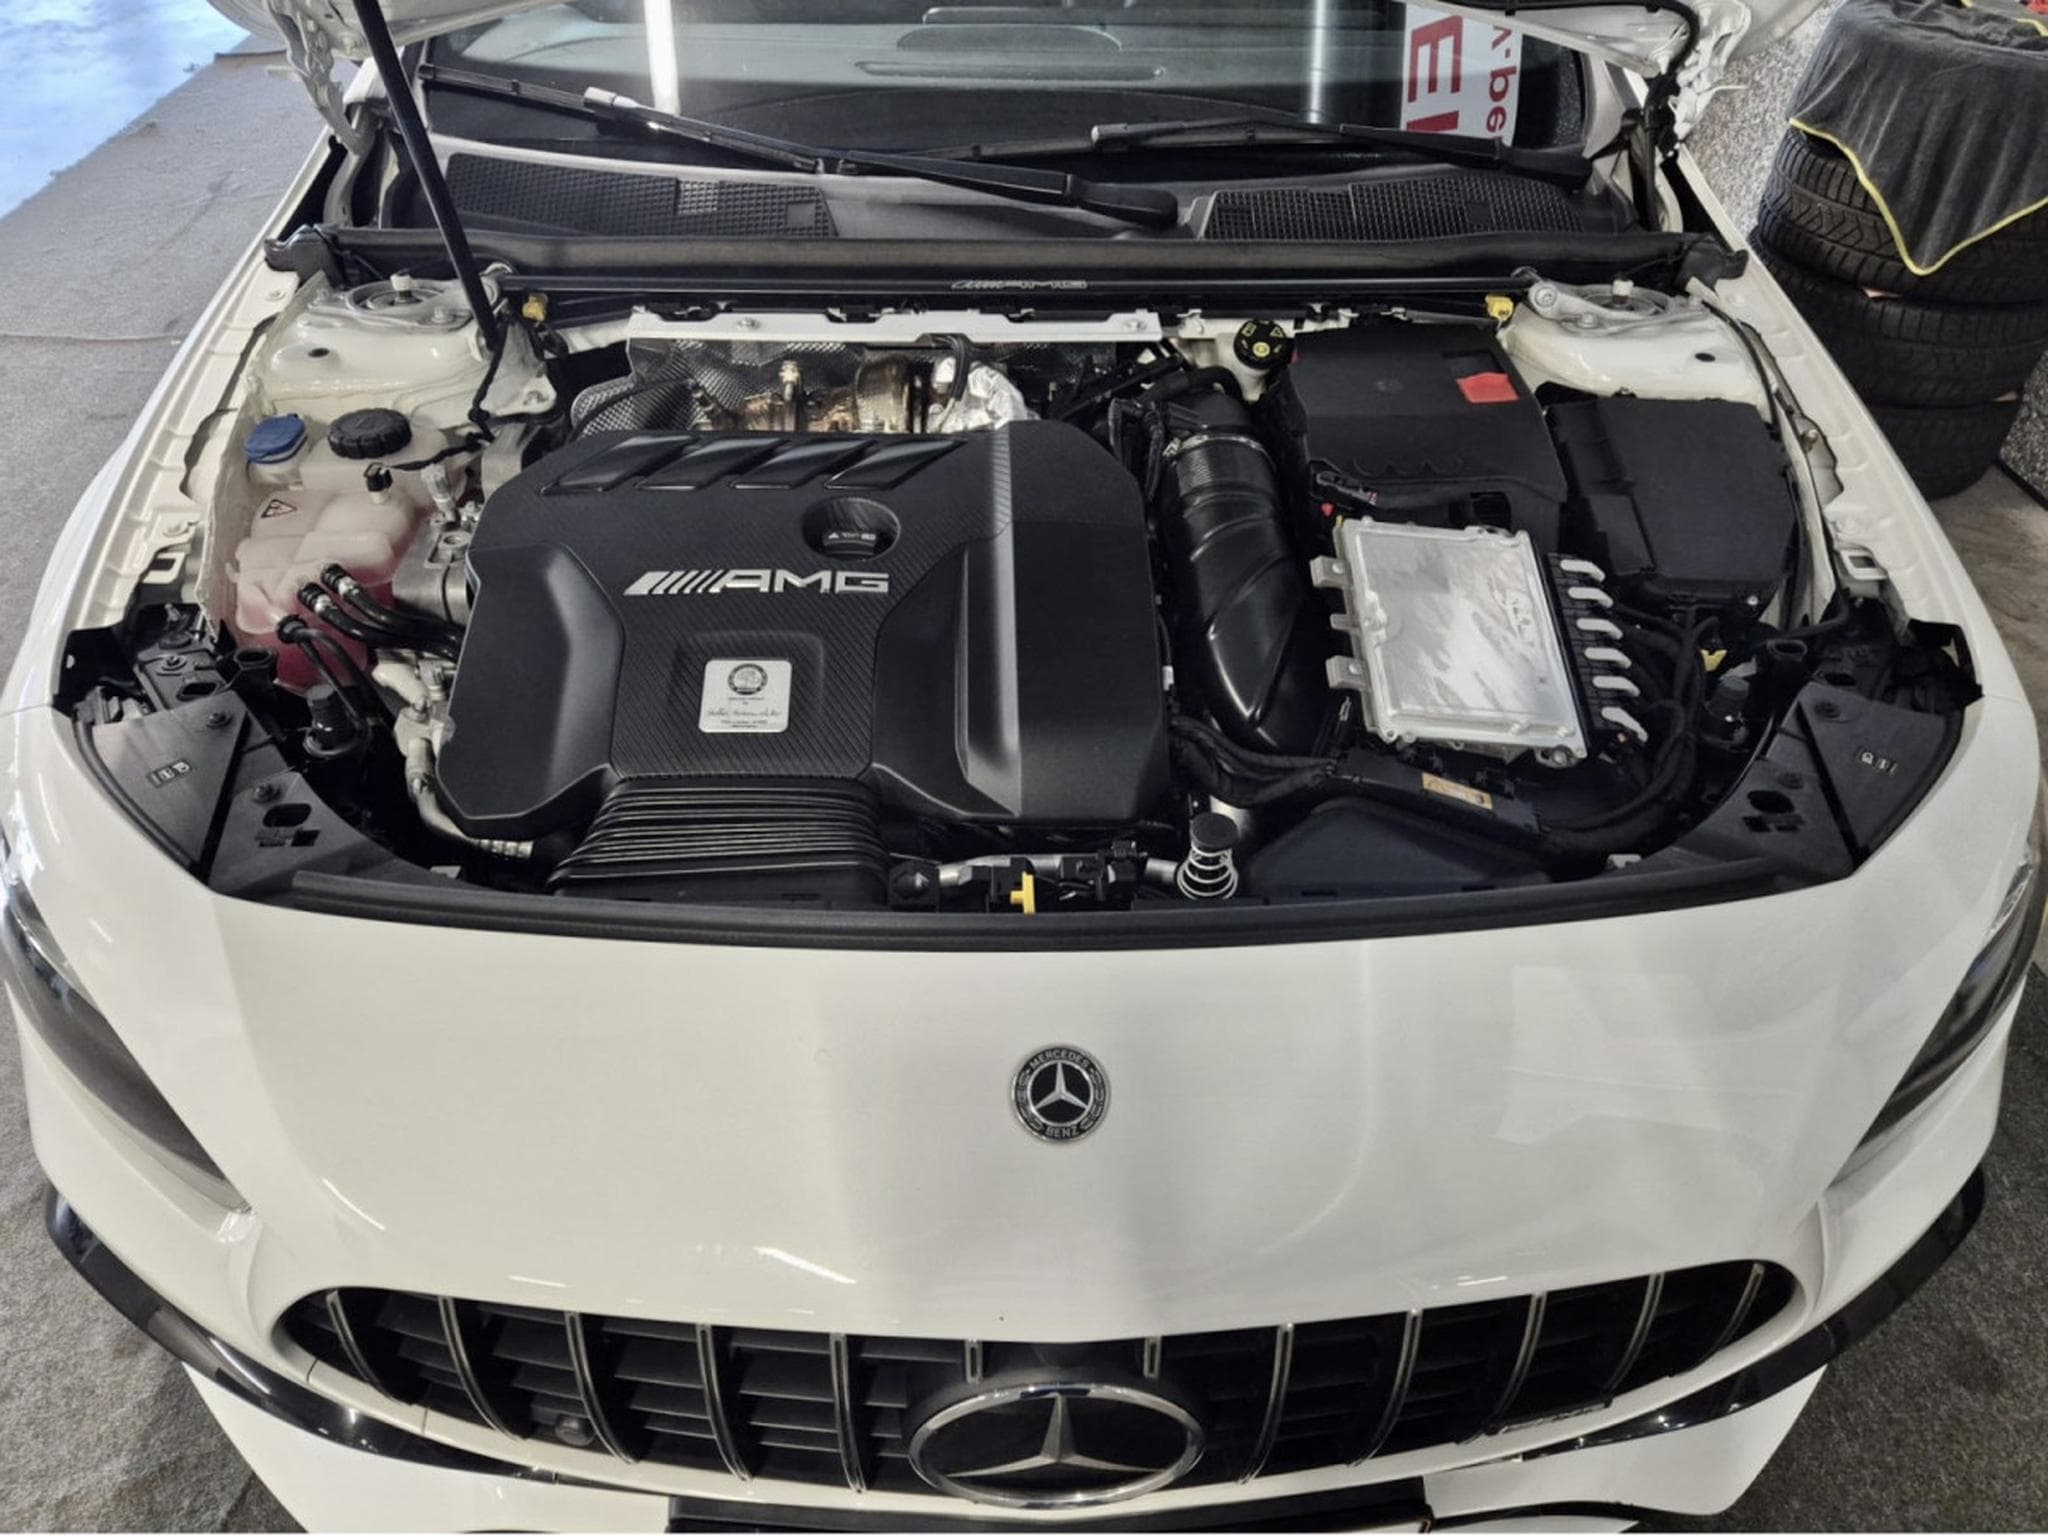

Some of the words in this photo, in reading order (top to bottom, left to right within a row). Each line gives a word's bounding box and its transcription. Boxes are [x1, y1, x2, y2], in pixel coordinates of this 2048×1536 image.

[709, 569, 889, 594] AMG
[1029, 1049, 1090, 1070] MERCEDES
[1044, 1125, 1080, 1138] BENZ
